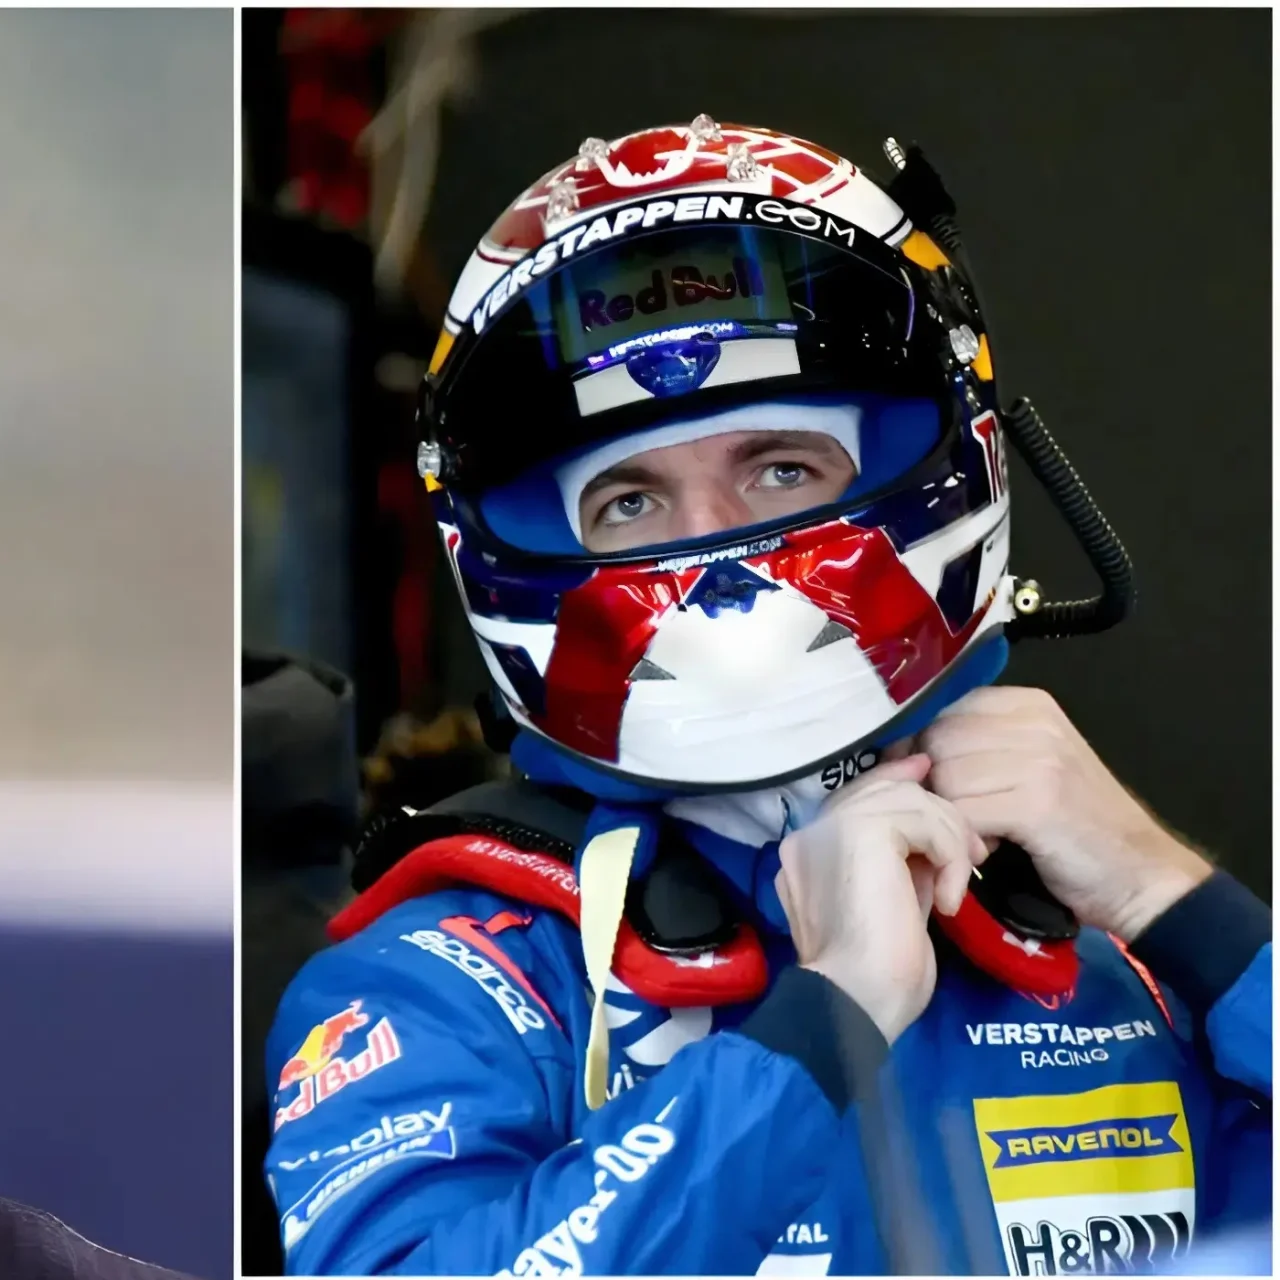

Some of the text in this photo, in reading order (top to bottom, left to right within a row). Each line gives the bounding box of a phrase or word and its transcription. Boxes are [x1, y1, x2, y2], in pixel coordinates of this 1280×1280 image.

[472, 195, 856, 335] VERSTAPPEN.COM
[578, 269, 668, 330] Red
[399, 930, 546, 1034] sparco
[316, 1016, 402, 1104] Bull
[966, 1019, 1157, 1046] VERSTAPPEN
[1021, 1048, 1109, 1069] RACING
[1007, 1127, 1164, 1157] RAVENOL
[494, 1169, 618, 1275] ayer
[777, 1222, 829, 1244] TAL
[1010, 1219, 1125, 1276] H&R
